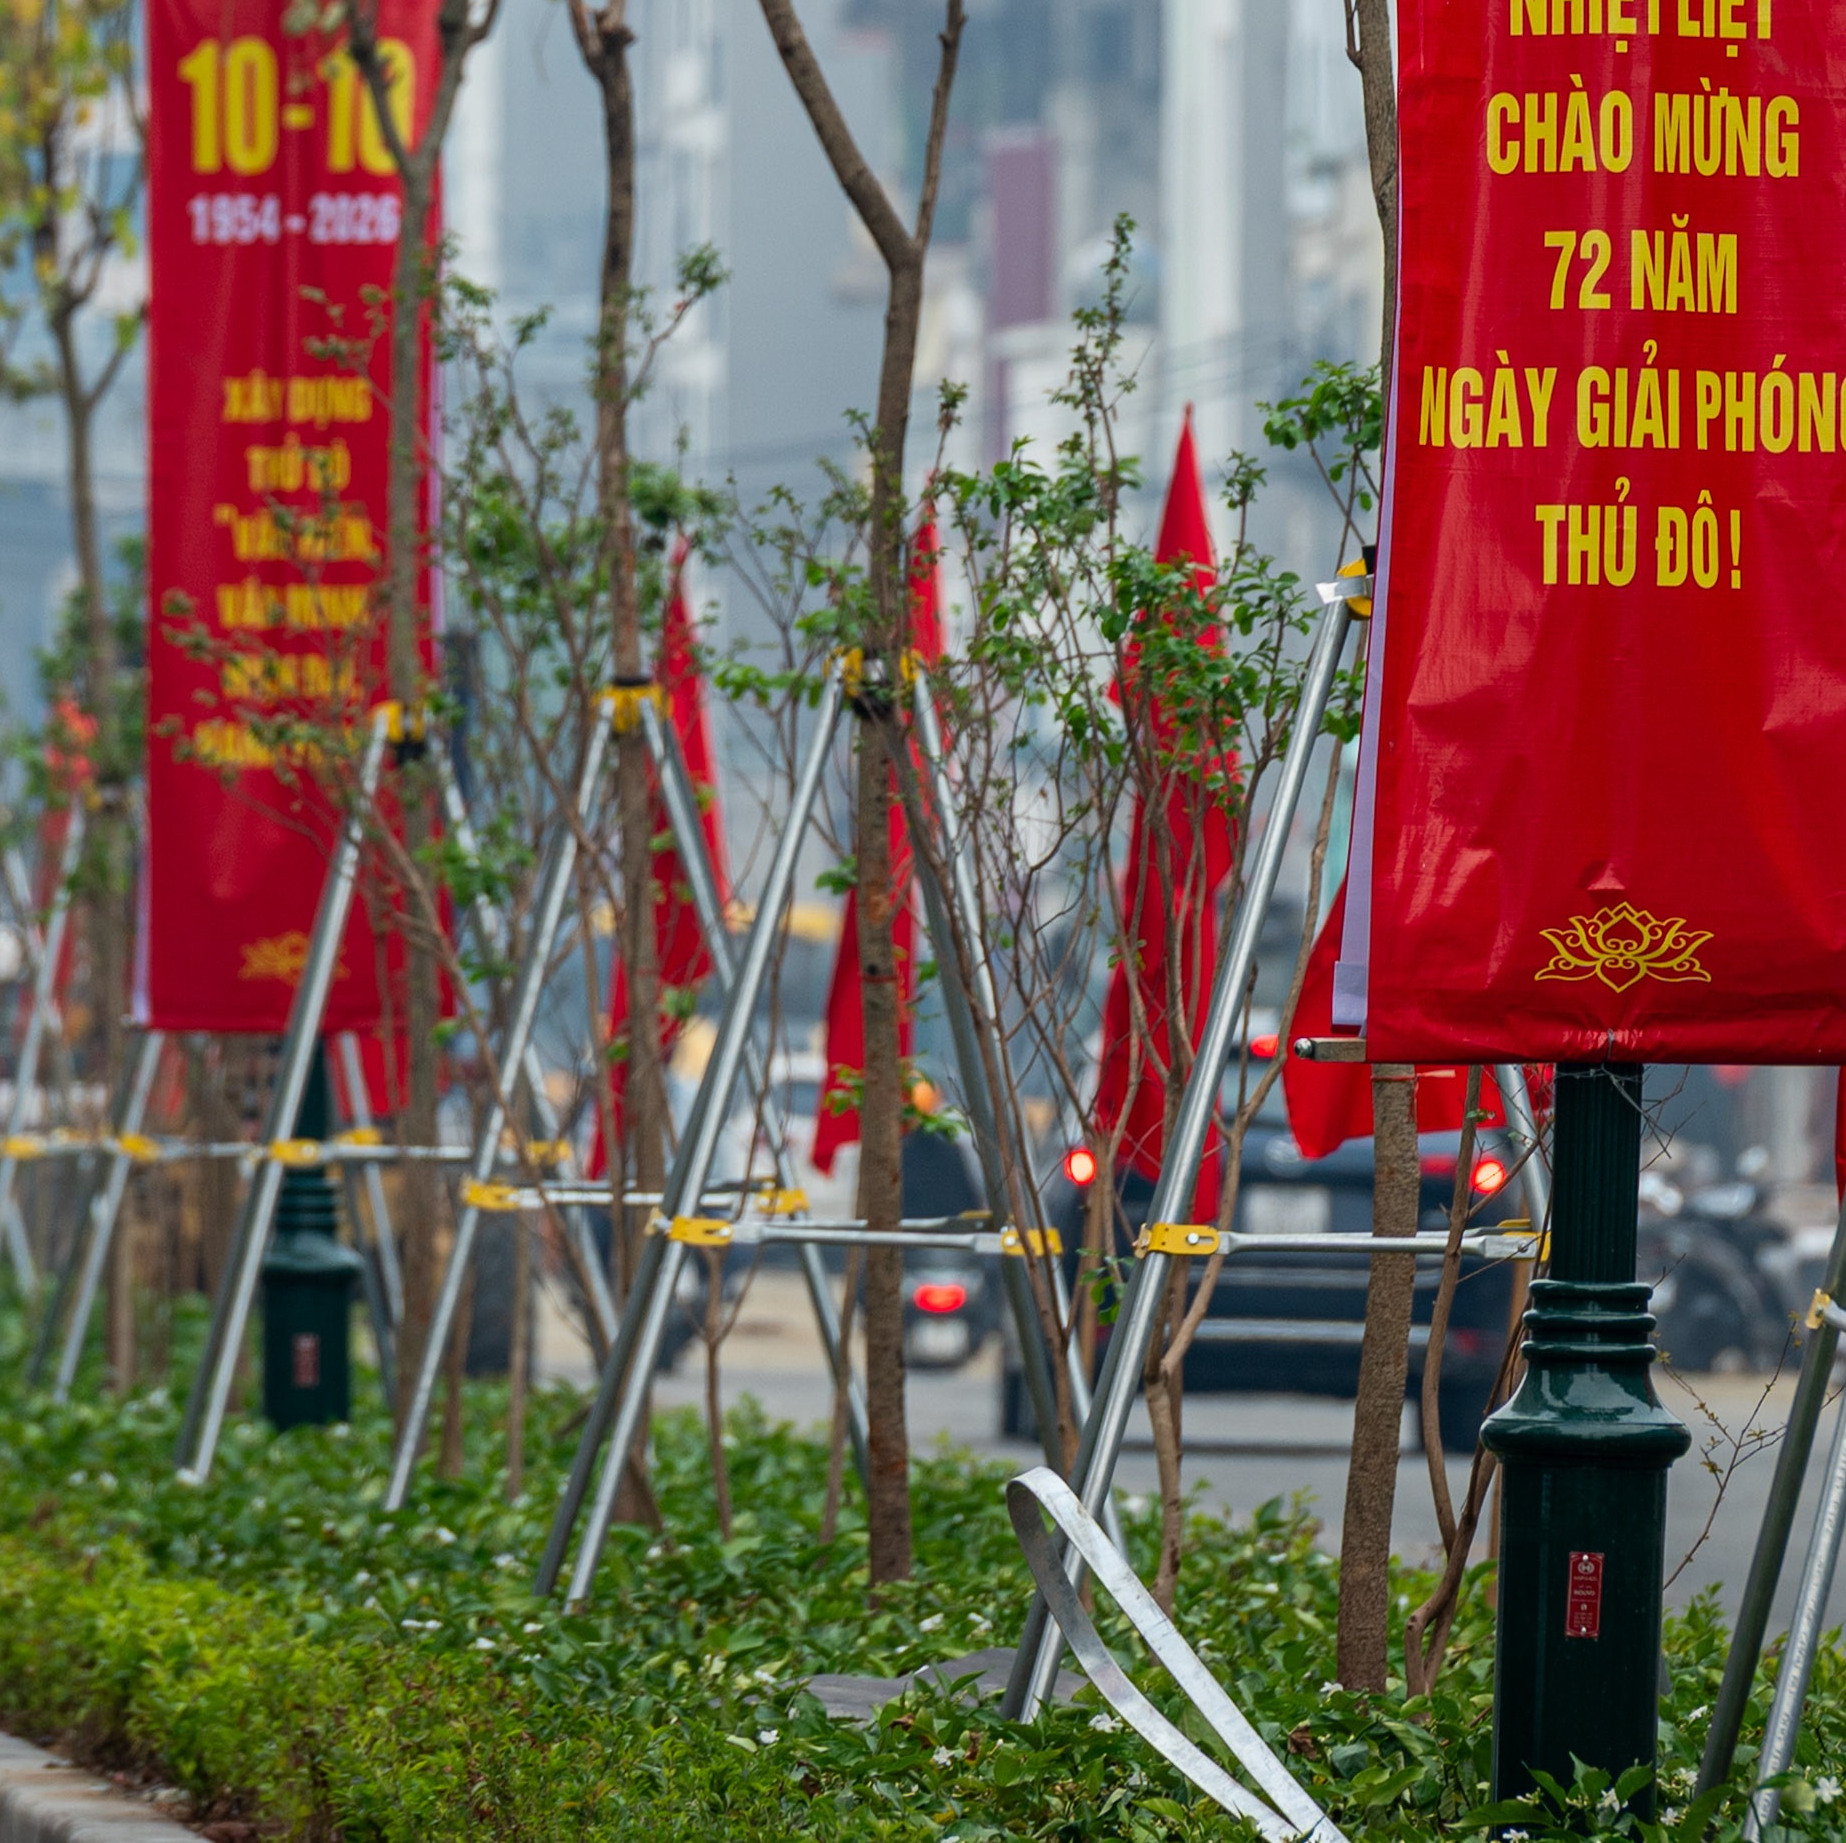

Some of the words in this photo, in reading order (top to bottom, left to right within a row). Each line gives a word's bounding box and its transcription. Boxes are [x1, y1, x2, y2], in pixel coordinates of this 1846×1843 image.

[1486, 73, 1633, 175] CHÀO
[1654, 77, 1801, 178] MỪNG
[187, 192, 282, 245] 1954
[309, 191, 400, 245] 2026
[1544, 228, 1612, 310] 72
[1630, 214, 1738, 314] NĂM
[1418, 349, 1558, 449] NGÀY
[1576, 339, 1681, 449] GIẢI
[1535, 476, 1638, 587] THỦ
